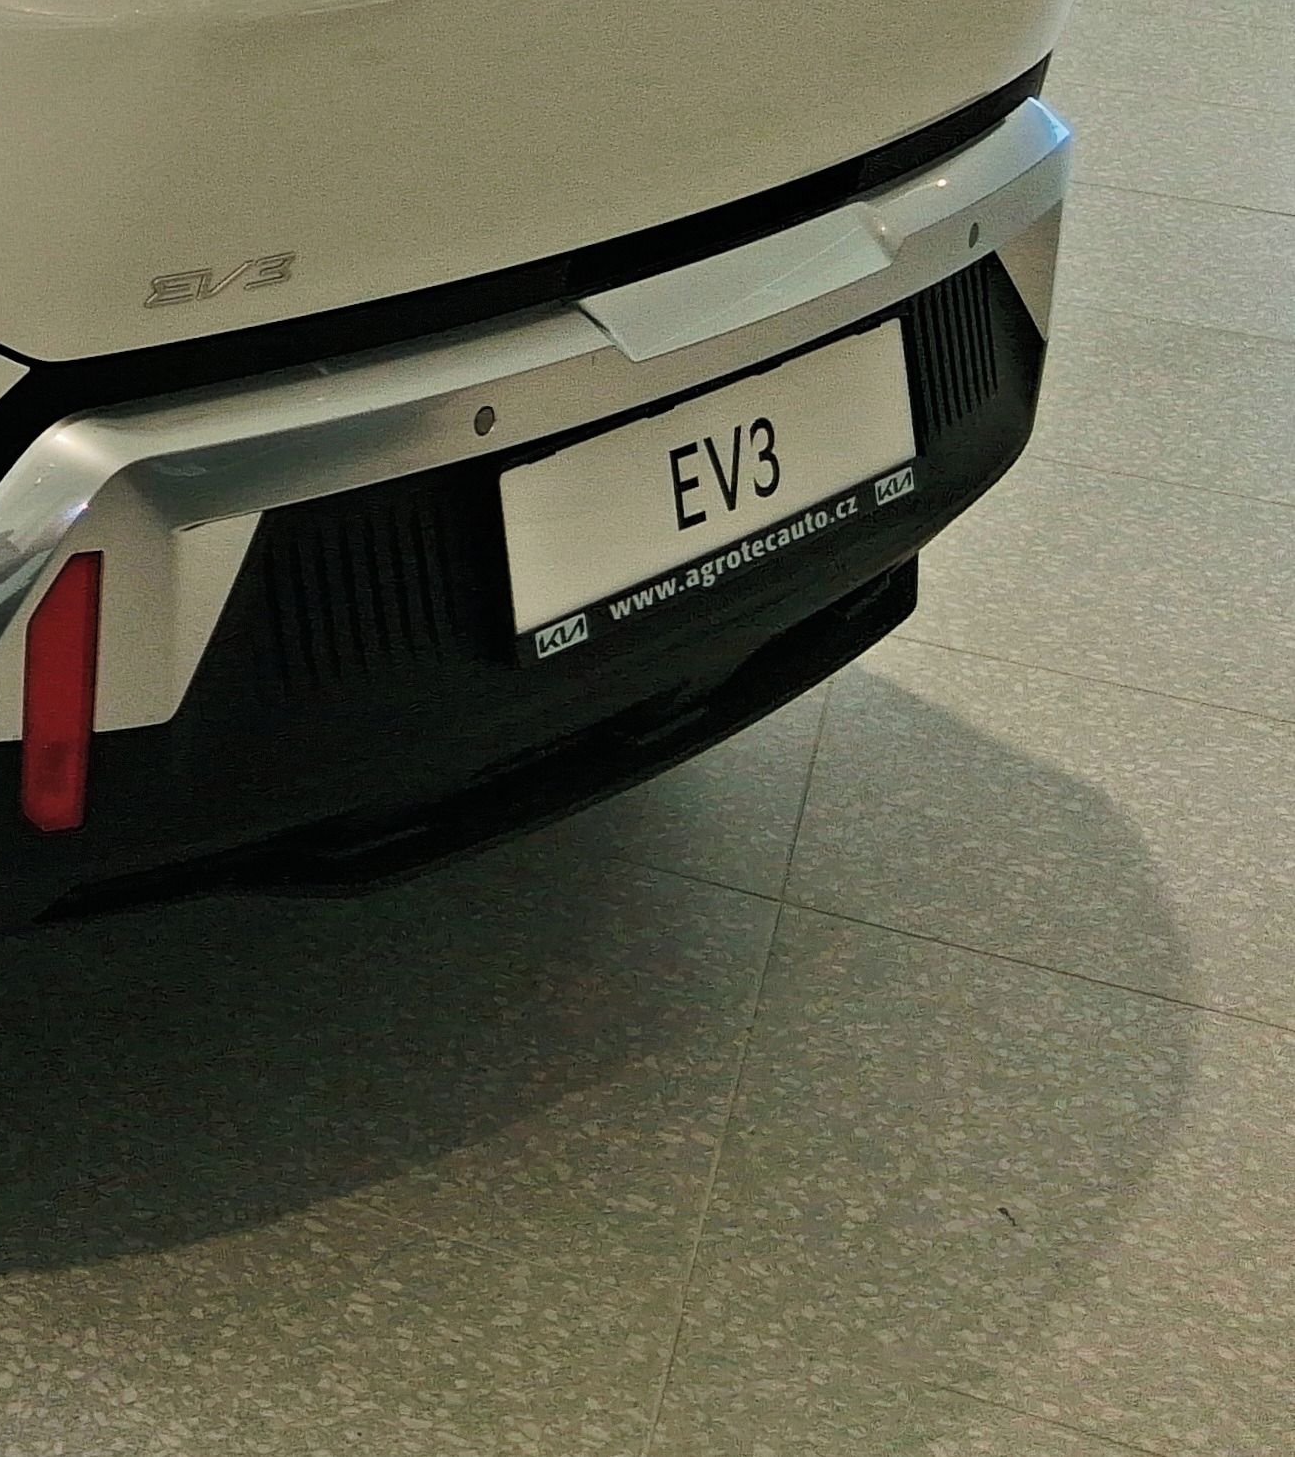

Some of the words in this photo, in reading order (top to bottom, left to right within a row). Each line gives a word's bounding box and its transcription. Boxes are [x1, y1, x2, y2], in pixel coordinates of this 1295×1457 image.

[144, 250, 297, 309] EV3
[668, 416, 782, 532] EV3
[537, 615, 586, 655] KIA
[609, 494, 859, 621] www.agrotecauto.cz
[876, 470, 912, 503] KIA
